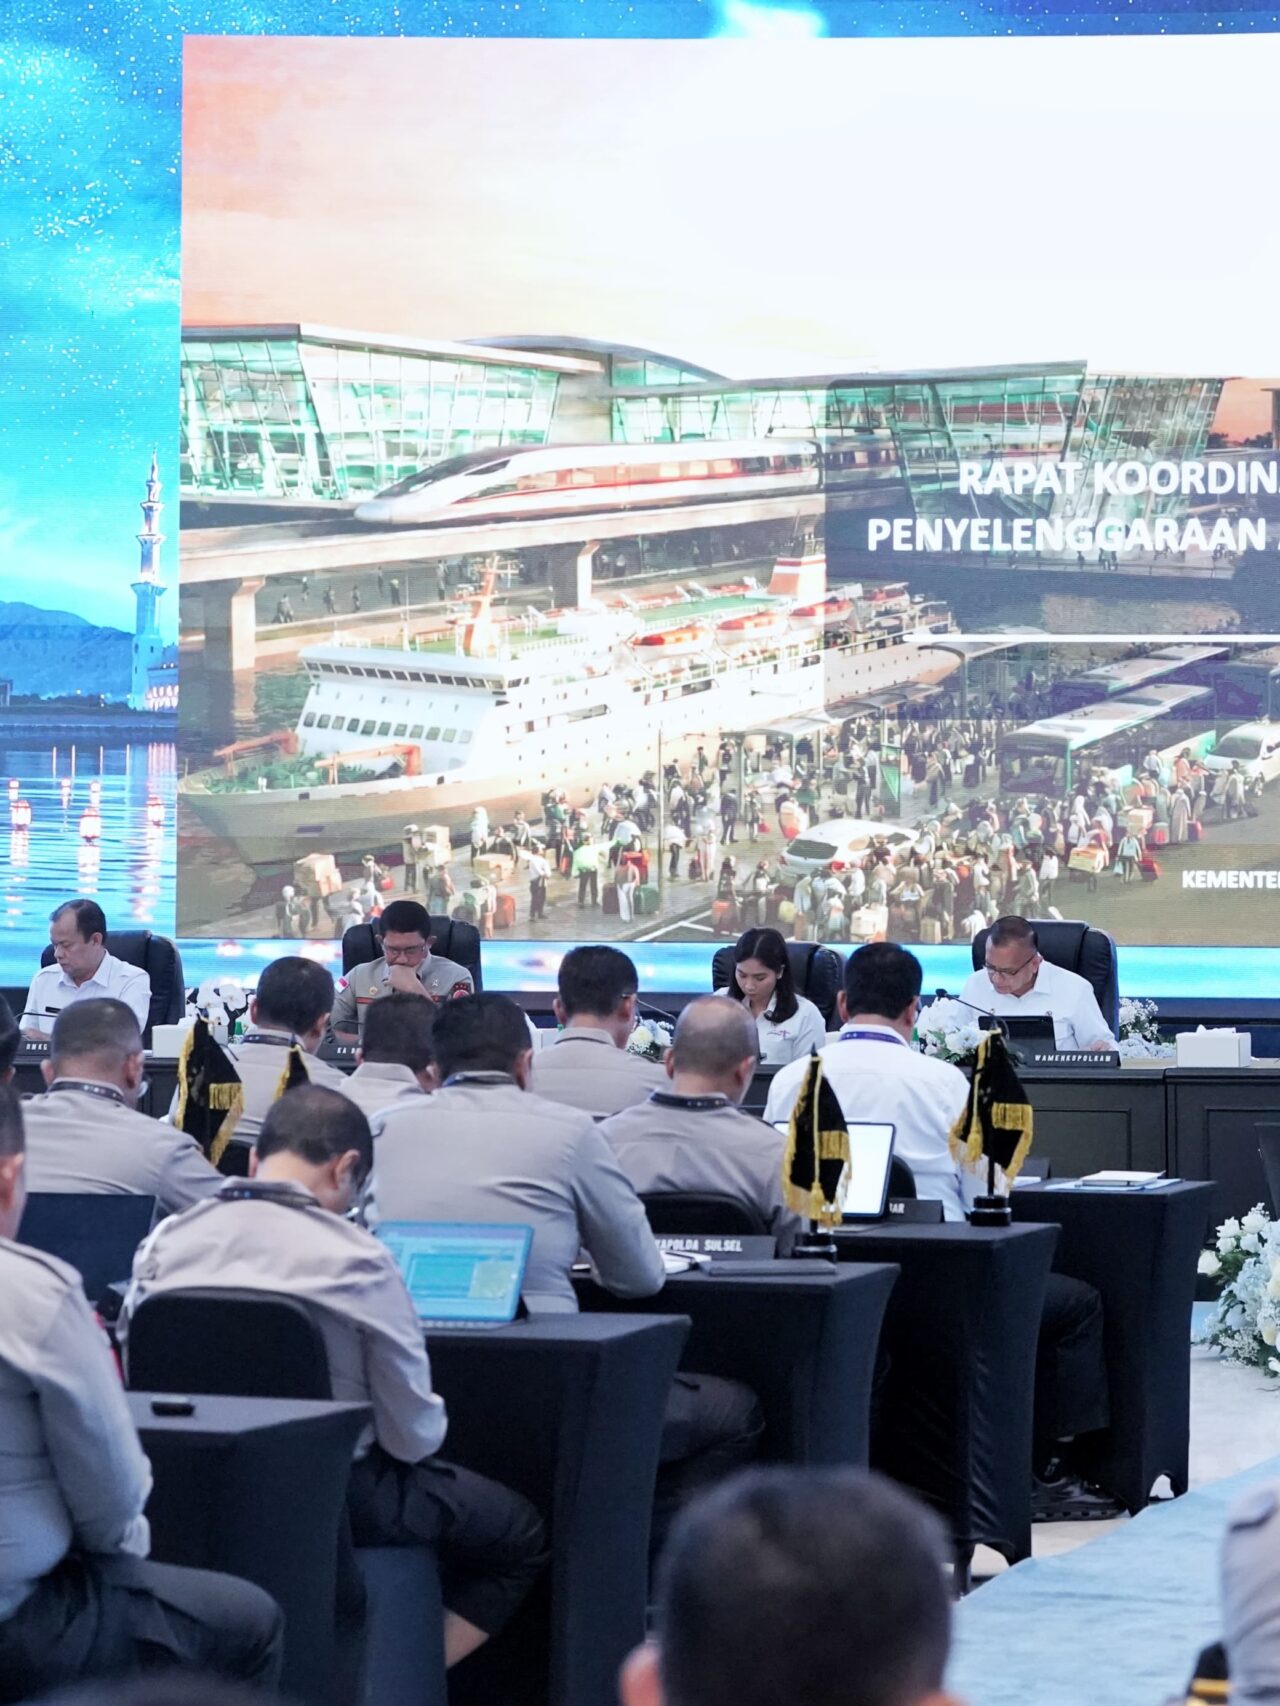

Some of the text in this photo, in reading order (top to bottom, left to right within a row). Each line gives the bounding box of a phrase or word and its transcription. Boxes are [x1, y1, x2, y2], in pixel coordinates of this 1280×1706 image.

[959, 461, 1083, 495] RAPAT
[867, 517, 1267, 552] PENYELENGGARAAN
[704, 1239, 743, 1252] SULSEL
